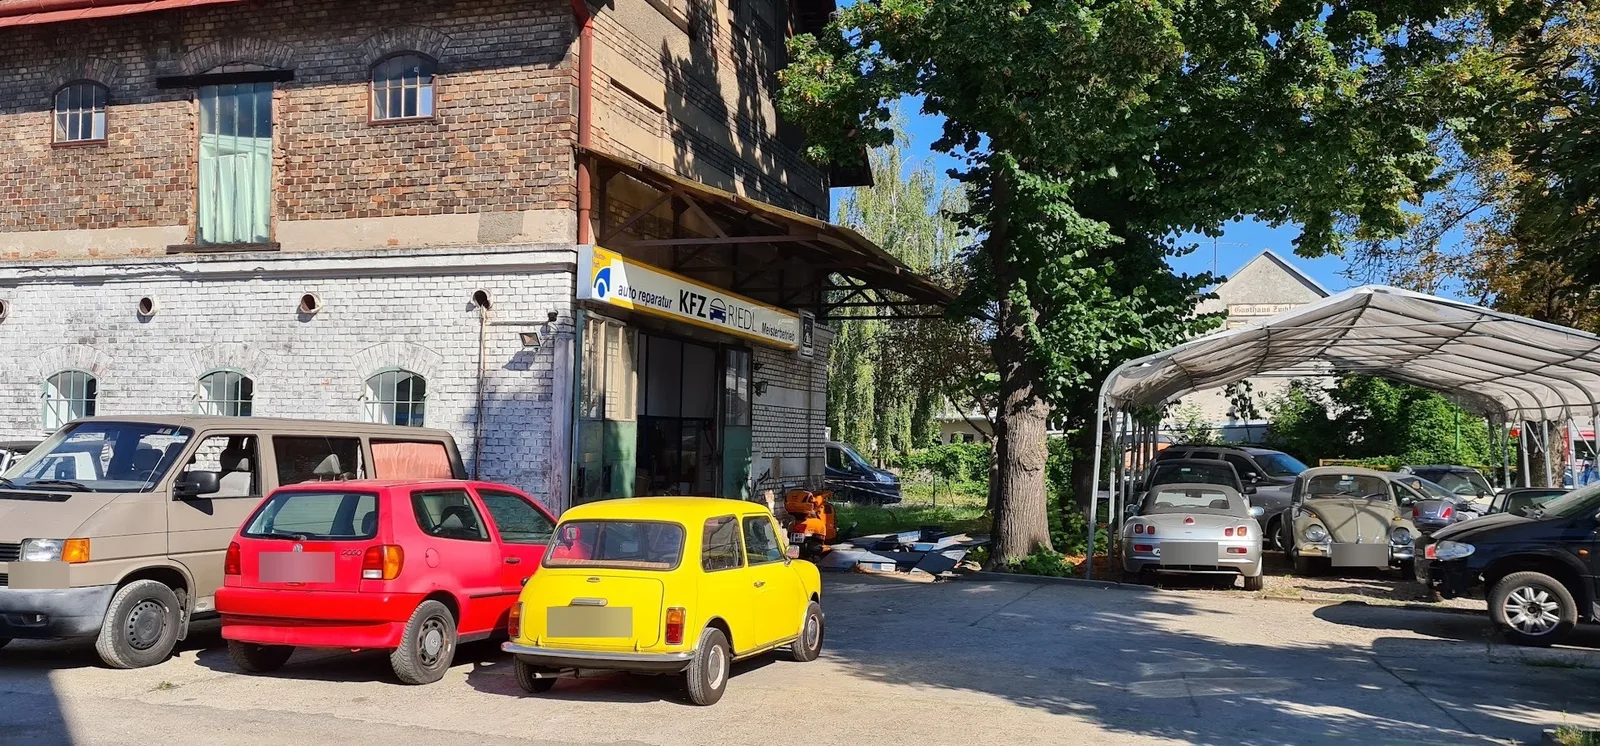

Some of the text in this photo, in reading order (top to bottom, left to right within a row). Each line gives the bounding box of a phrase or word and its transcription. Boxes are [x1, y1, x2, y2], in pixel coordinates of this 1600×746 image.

[618, 284, 673, 308] auto reparatur
[679, 289, 757, 332] KFZ RIEDL
[761, 321, 795, 341] Meisterbetrieb
